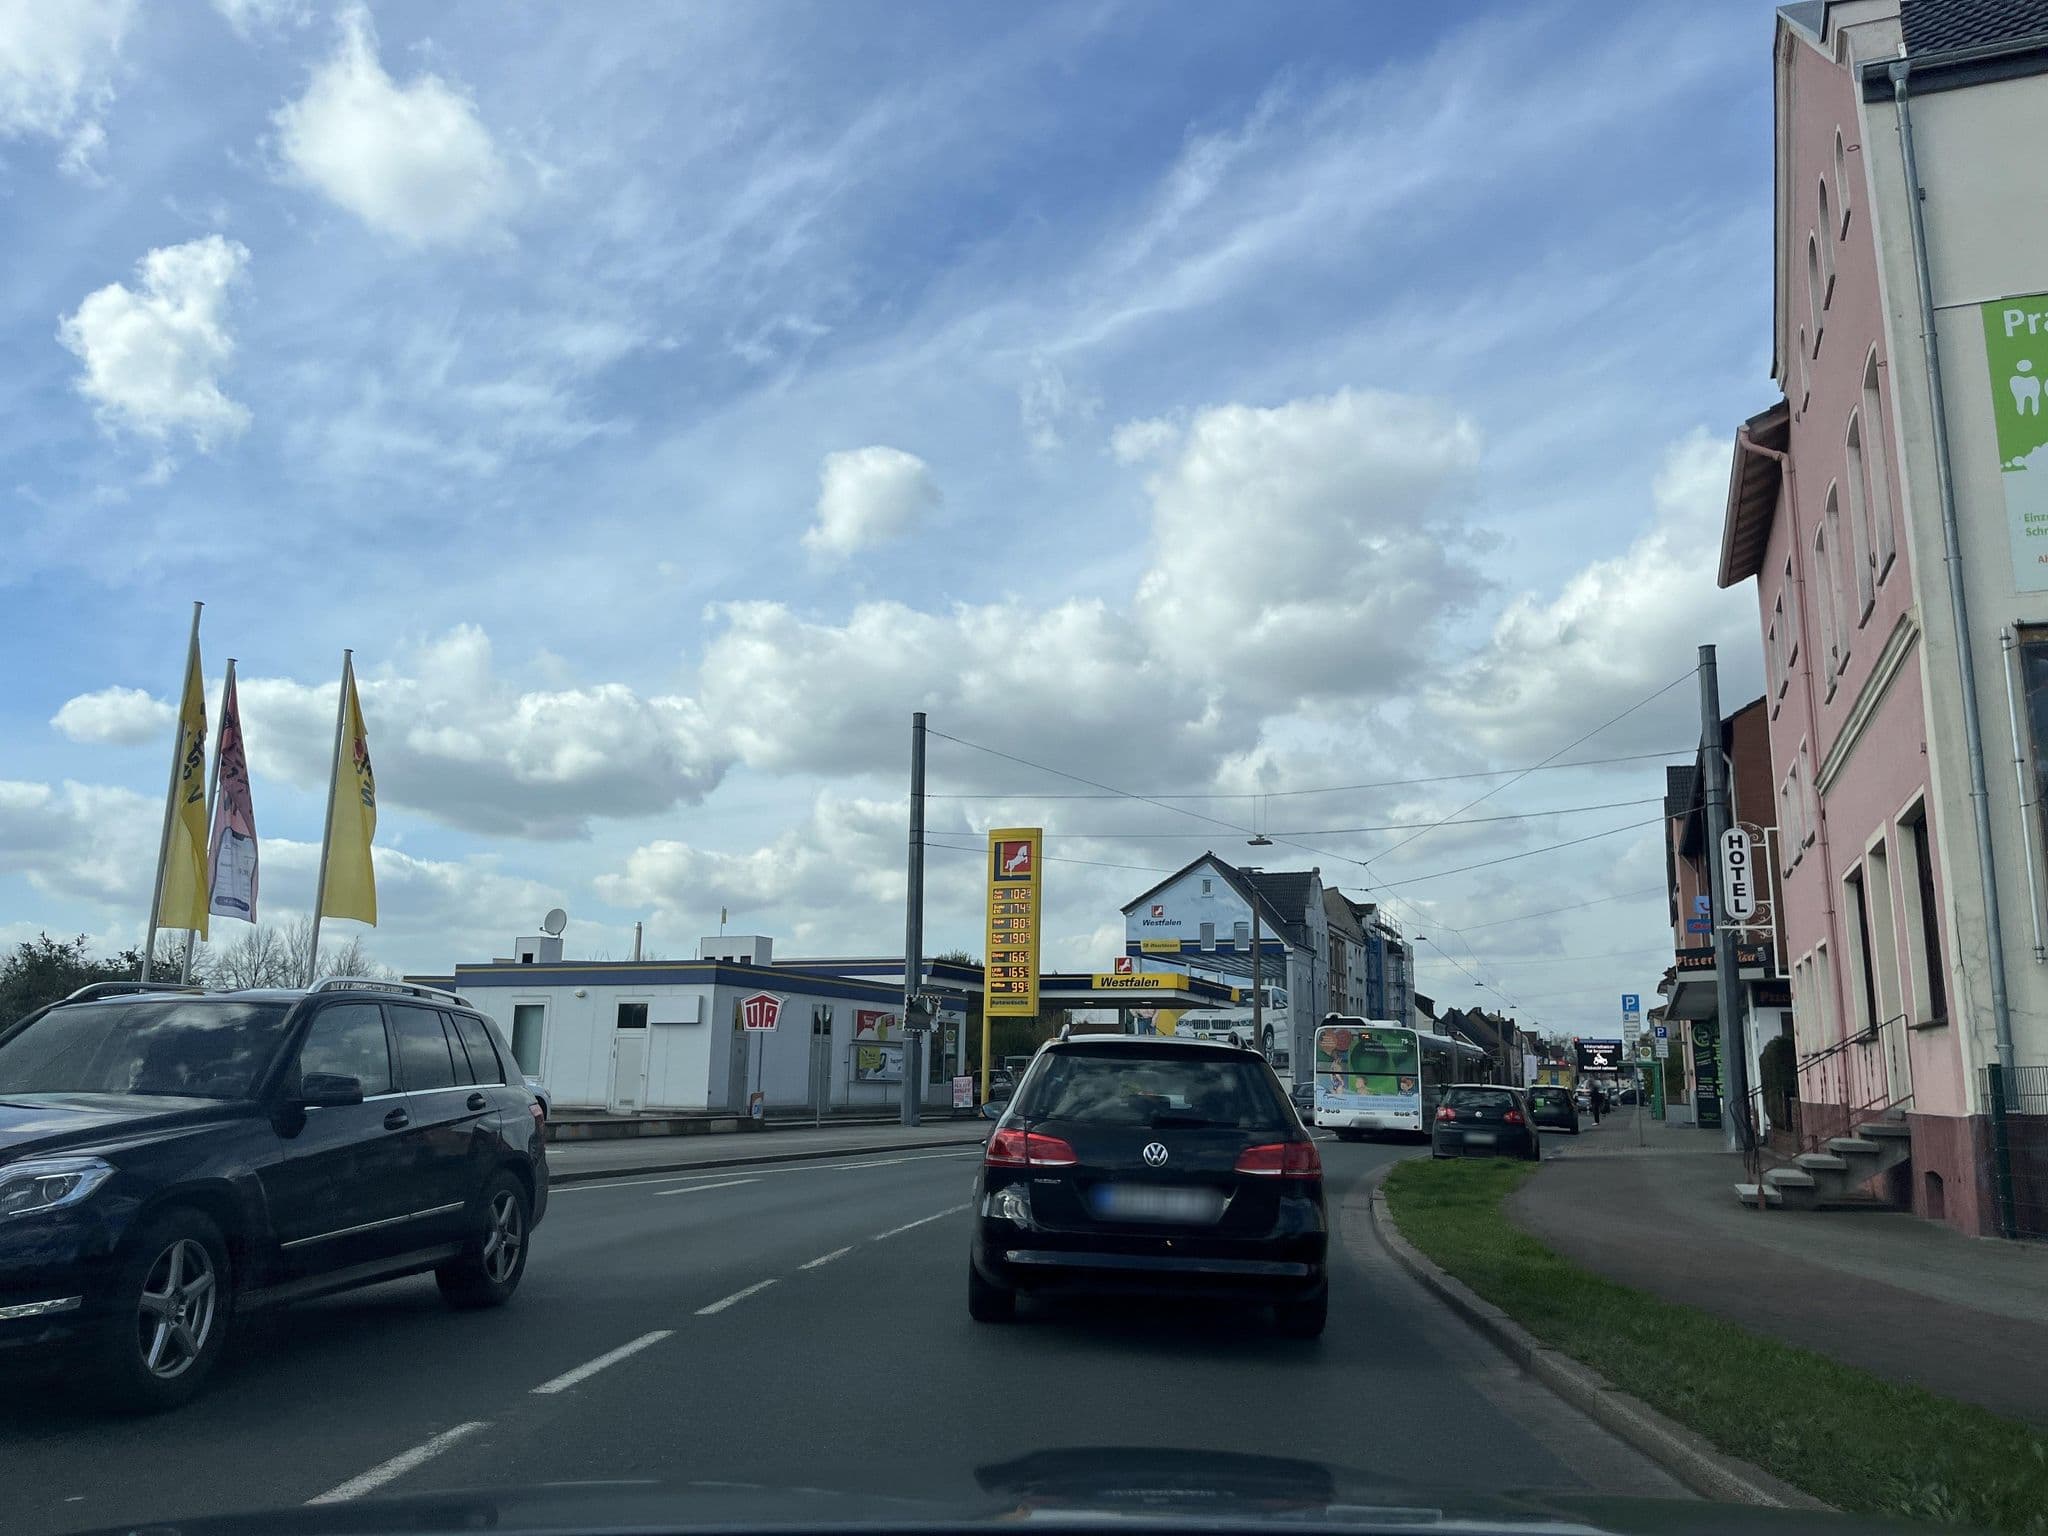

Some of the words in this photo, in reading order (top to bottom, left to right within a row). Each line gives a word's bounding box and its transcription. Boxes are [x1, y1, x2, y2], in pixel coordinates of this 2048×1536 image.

[1727, 835, 1748, 913] HOTEL
[1142, 918, 1182, 927] Westfalen
[1101, 976, 1159, 988] Westfalen
[1625, 996, 1636, 1010] P
[745, 995, 779, 1027] UTA
[1656, 1027, 1665, 1037] P
